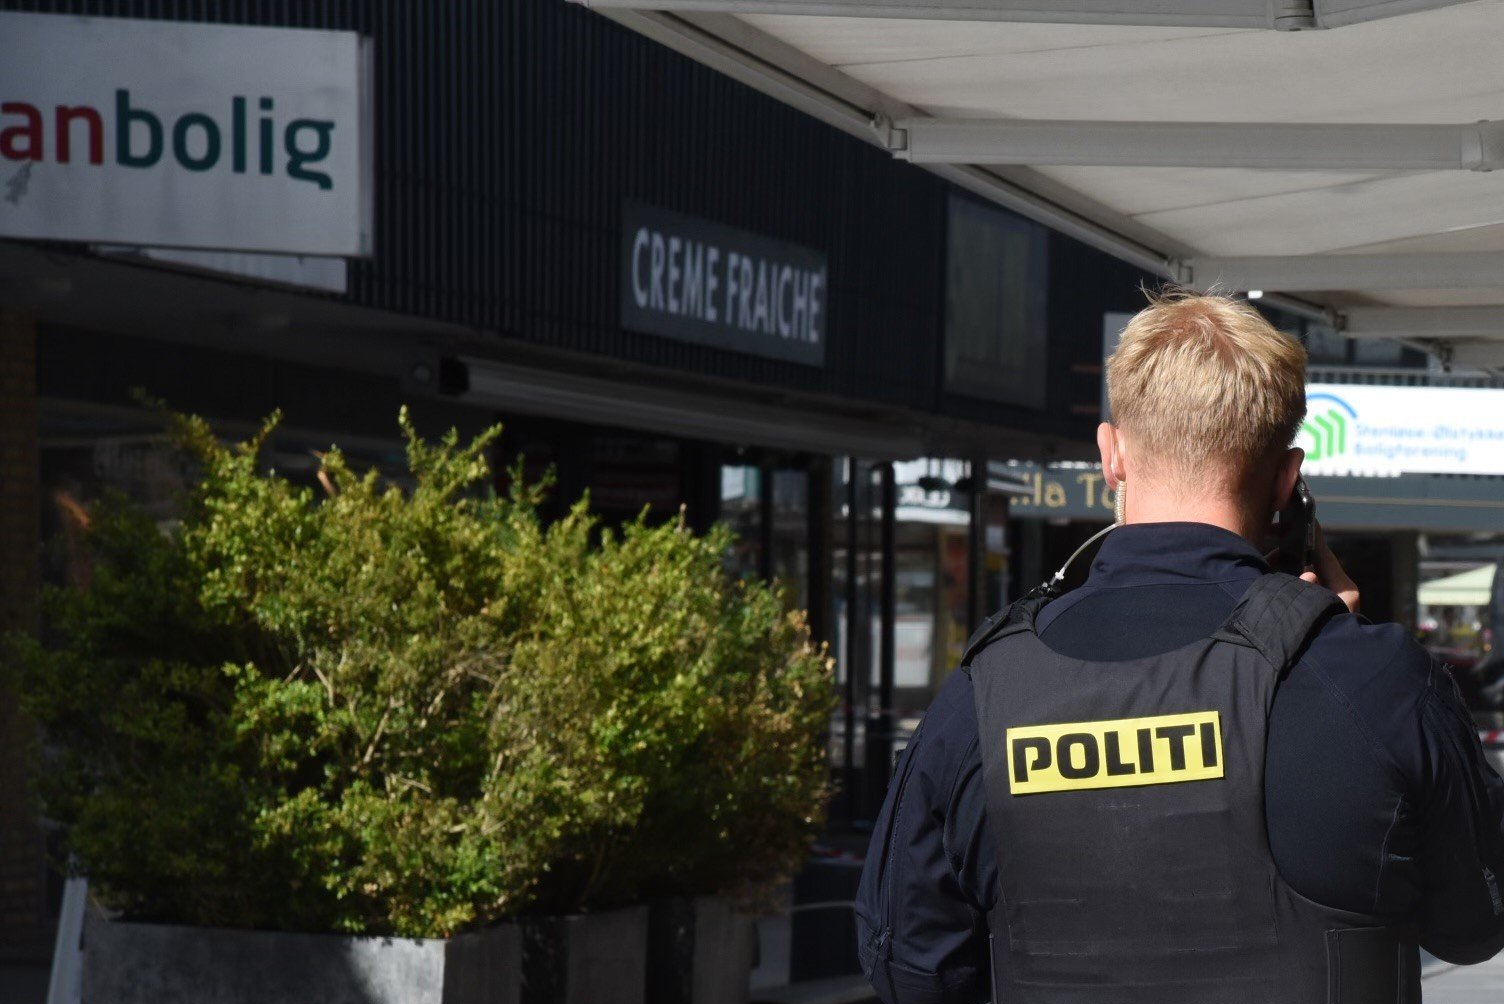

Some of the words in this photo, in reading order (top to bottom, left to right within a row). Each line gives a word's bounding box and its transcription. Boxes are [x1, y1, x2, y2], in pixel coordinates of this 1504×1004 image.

[632, 226, 719, 322] CREME
[725, 252, 821, 343] FRAICHE
[1012, 722, 1218, 784] POLITI
